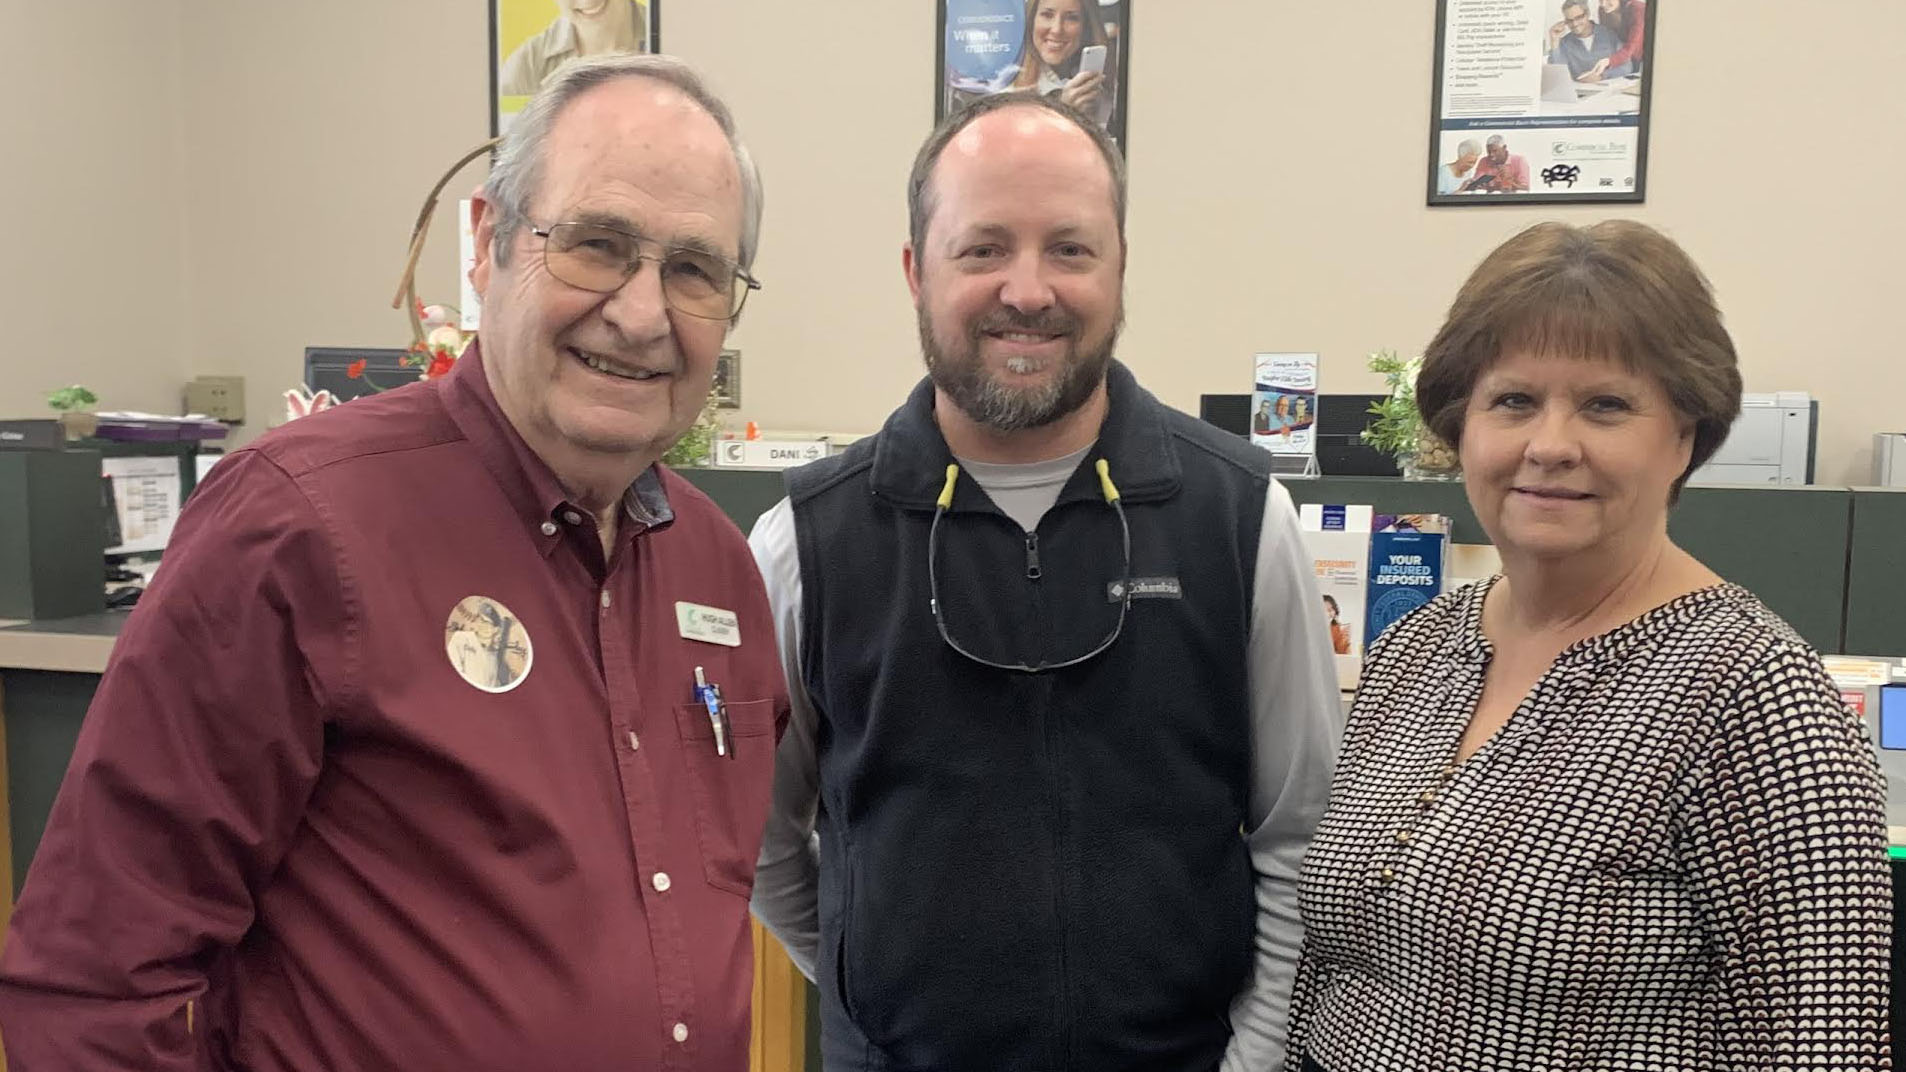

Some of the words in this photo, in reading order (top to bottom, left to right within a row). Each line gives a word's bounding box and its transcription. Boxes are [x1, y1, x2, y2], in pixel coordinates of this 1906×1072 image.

[954, 30, 988, 41] When
[965, 42, 1011, 54] matters
[770, 449, 800, 459] DANI
[1389, 555, 1422, 565] YOUR
[1380, 565, 1431, 575] INSURED
[1377, 575, 1434, 585] DEPOSITS
